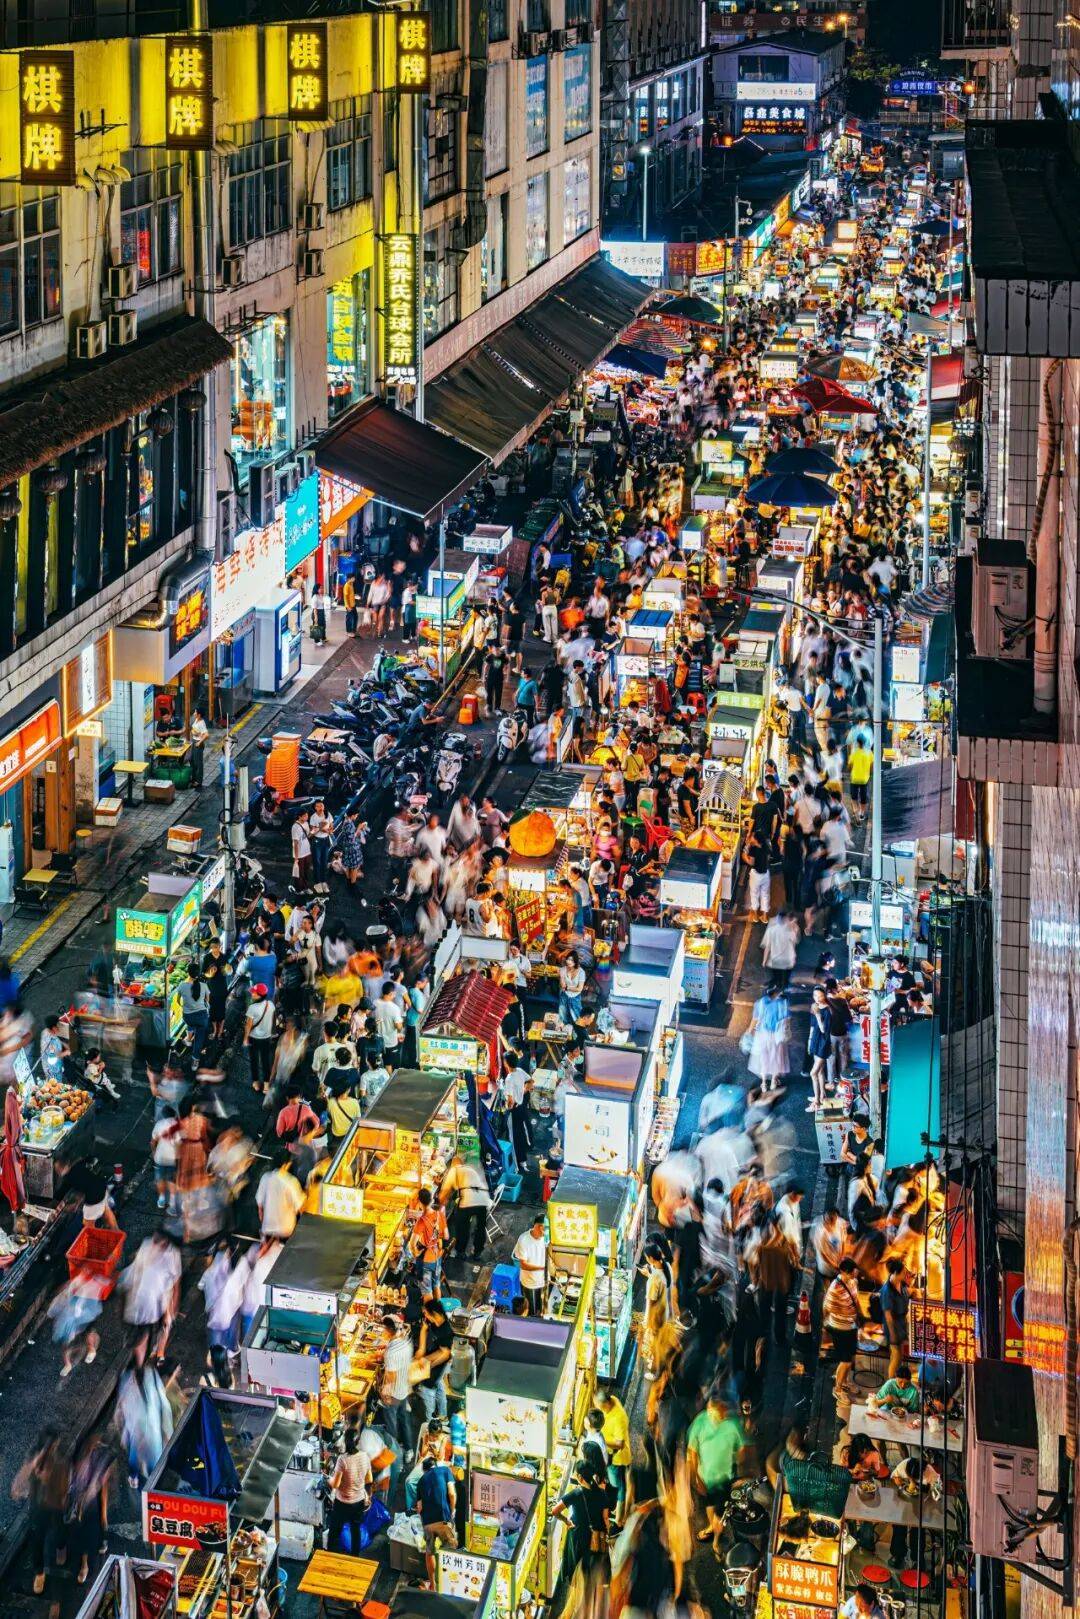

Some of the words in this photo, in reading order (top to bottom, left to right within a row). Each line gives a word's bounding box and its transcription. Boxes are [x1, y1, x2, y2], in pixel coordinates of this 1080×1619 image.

[290, 33, 320, 110] 棋牌
[399, 19, 425, 85] 棋牌
[24, 66, 62, 170] 棋牌
[169, 47, 203, 136] 棋牌
[388, 235, 412, 364] 云鼎乔氏台球会所
[151, 1516, 193, 1538] 臭豆腐
[183, 1503, 207, 1516] DOU
[776, 1563, 834, 1586] 酥脆鸭爪
